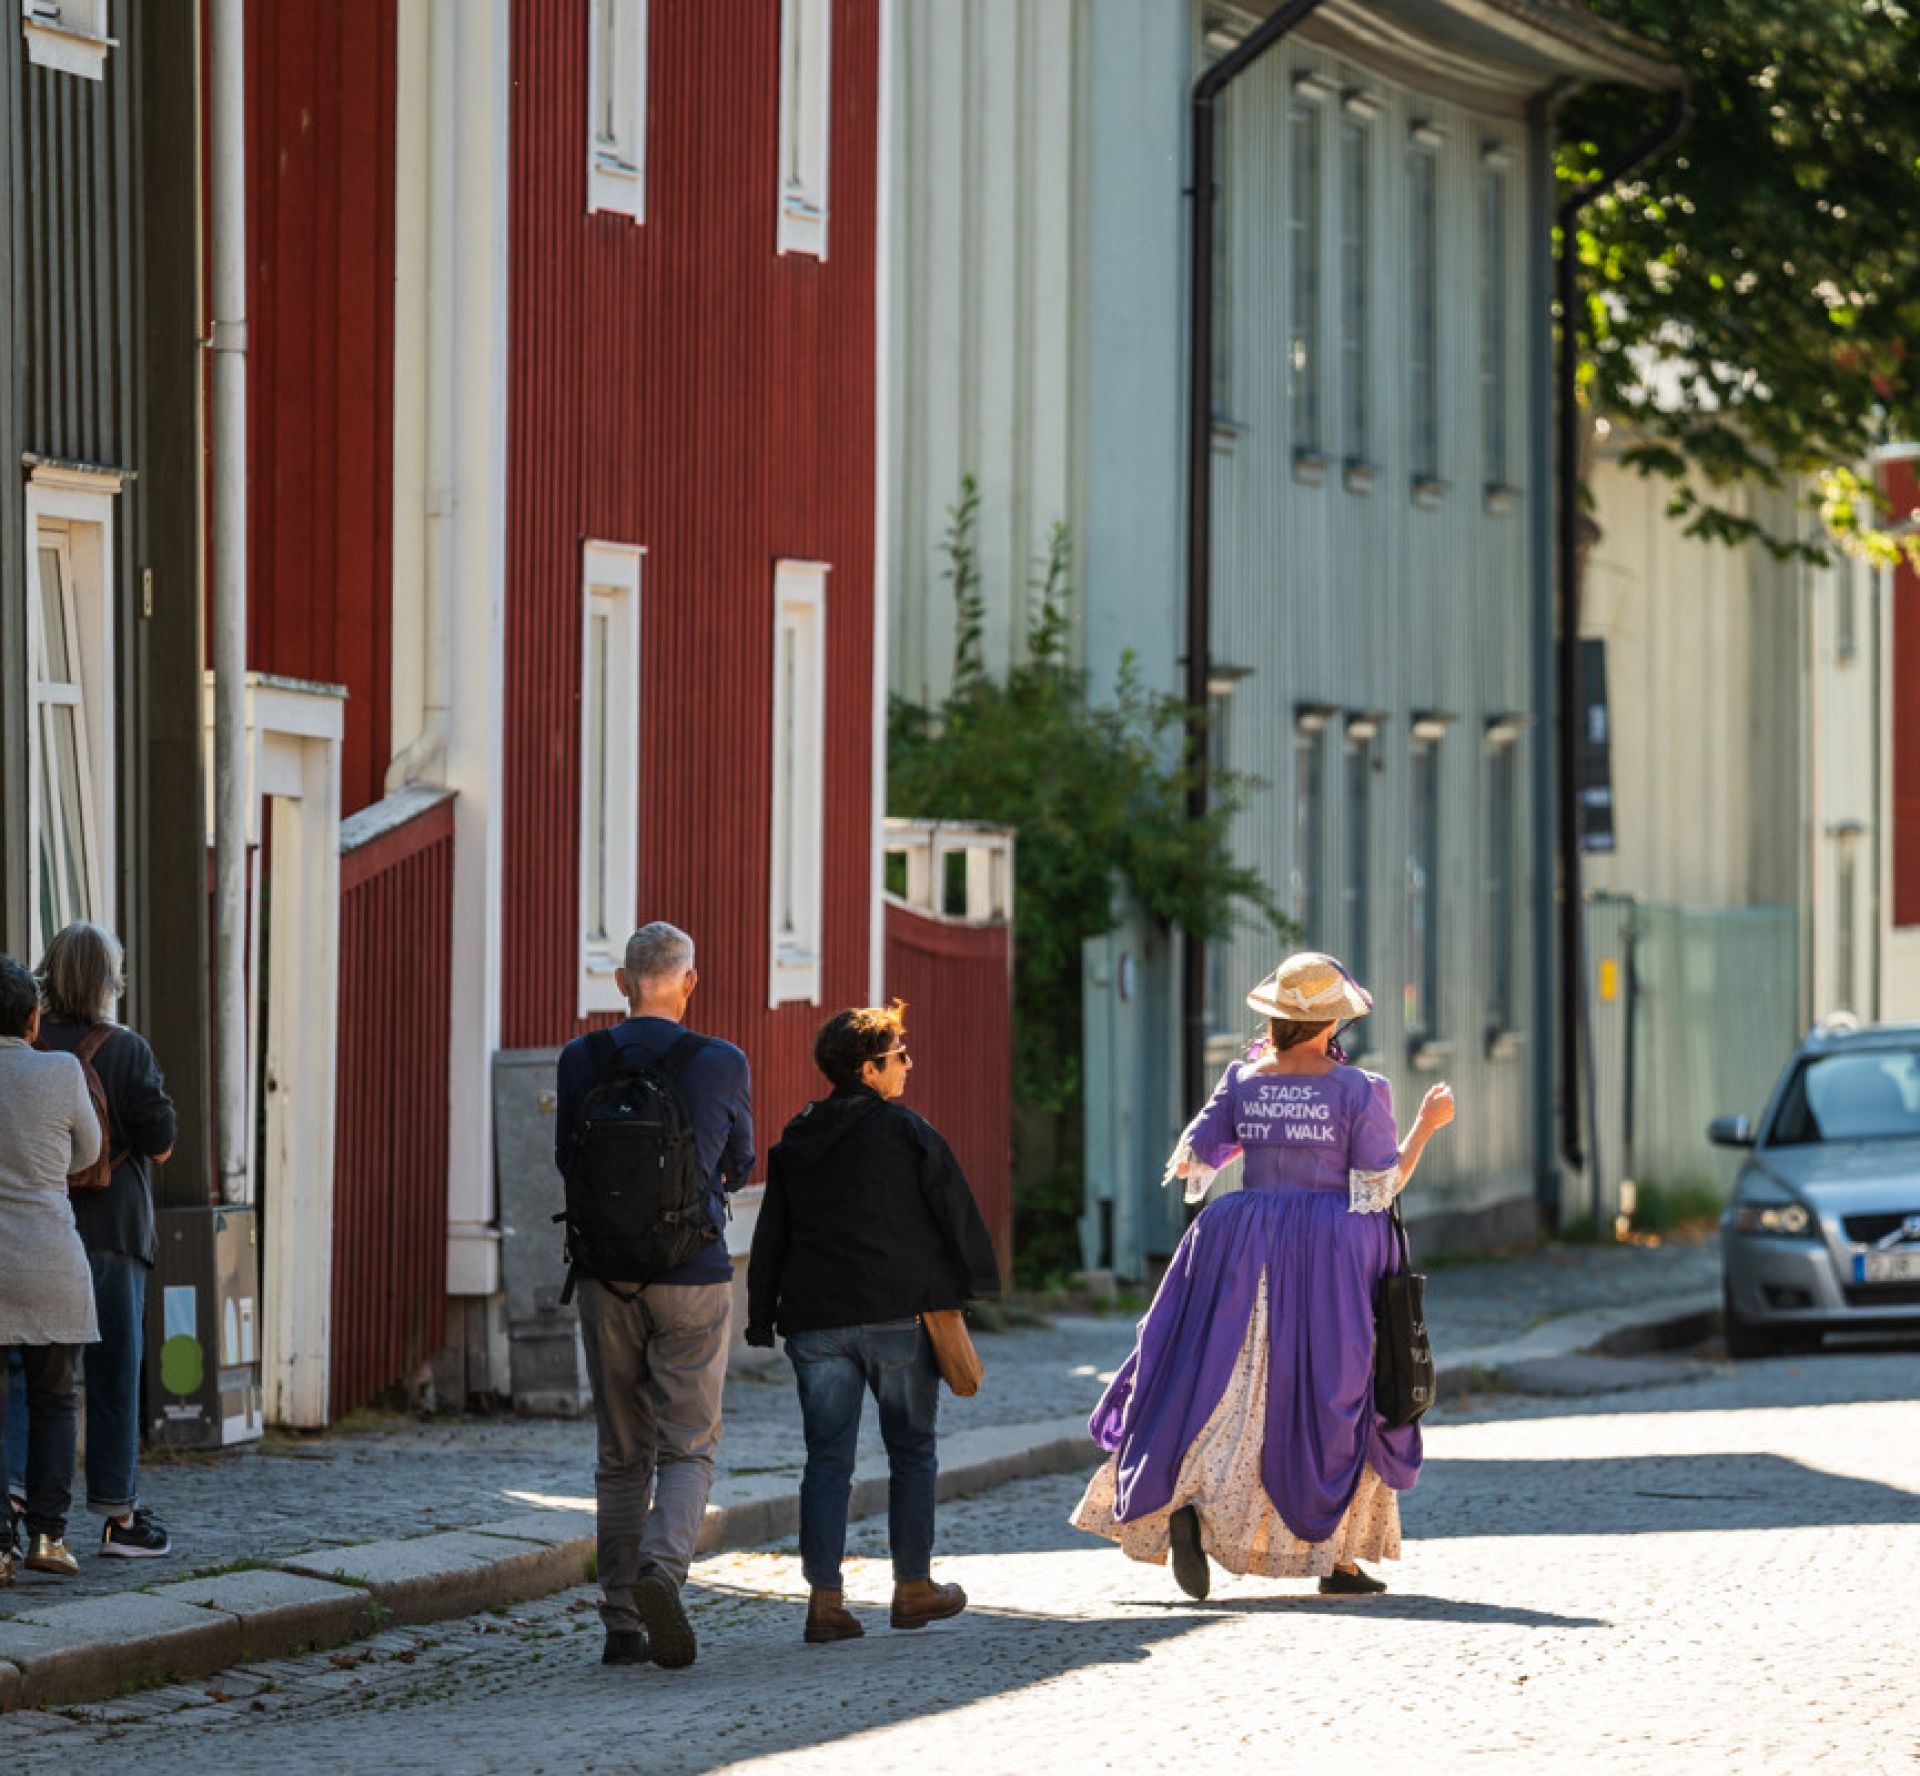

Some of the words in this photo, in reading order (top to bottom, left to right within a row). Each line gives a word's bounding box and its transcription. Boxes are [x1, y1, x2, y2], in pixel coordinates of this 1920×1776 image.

[1259, 1085, 1321, 1101] STADS-
[1243, 1101, 1330, 1120] VANDRING
[1237, 1122, 1272, 1139] CITY
[1285, 1123, 1335, 1141] WALK
